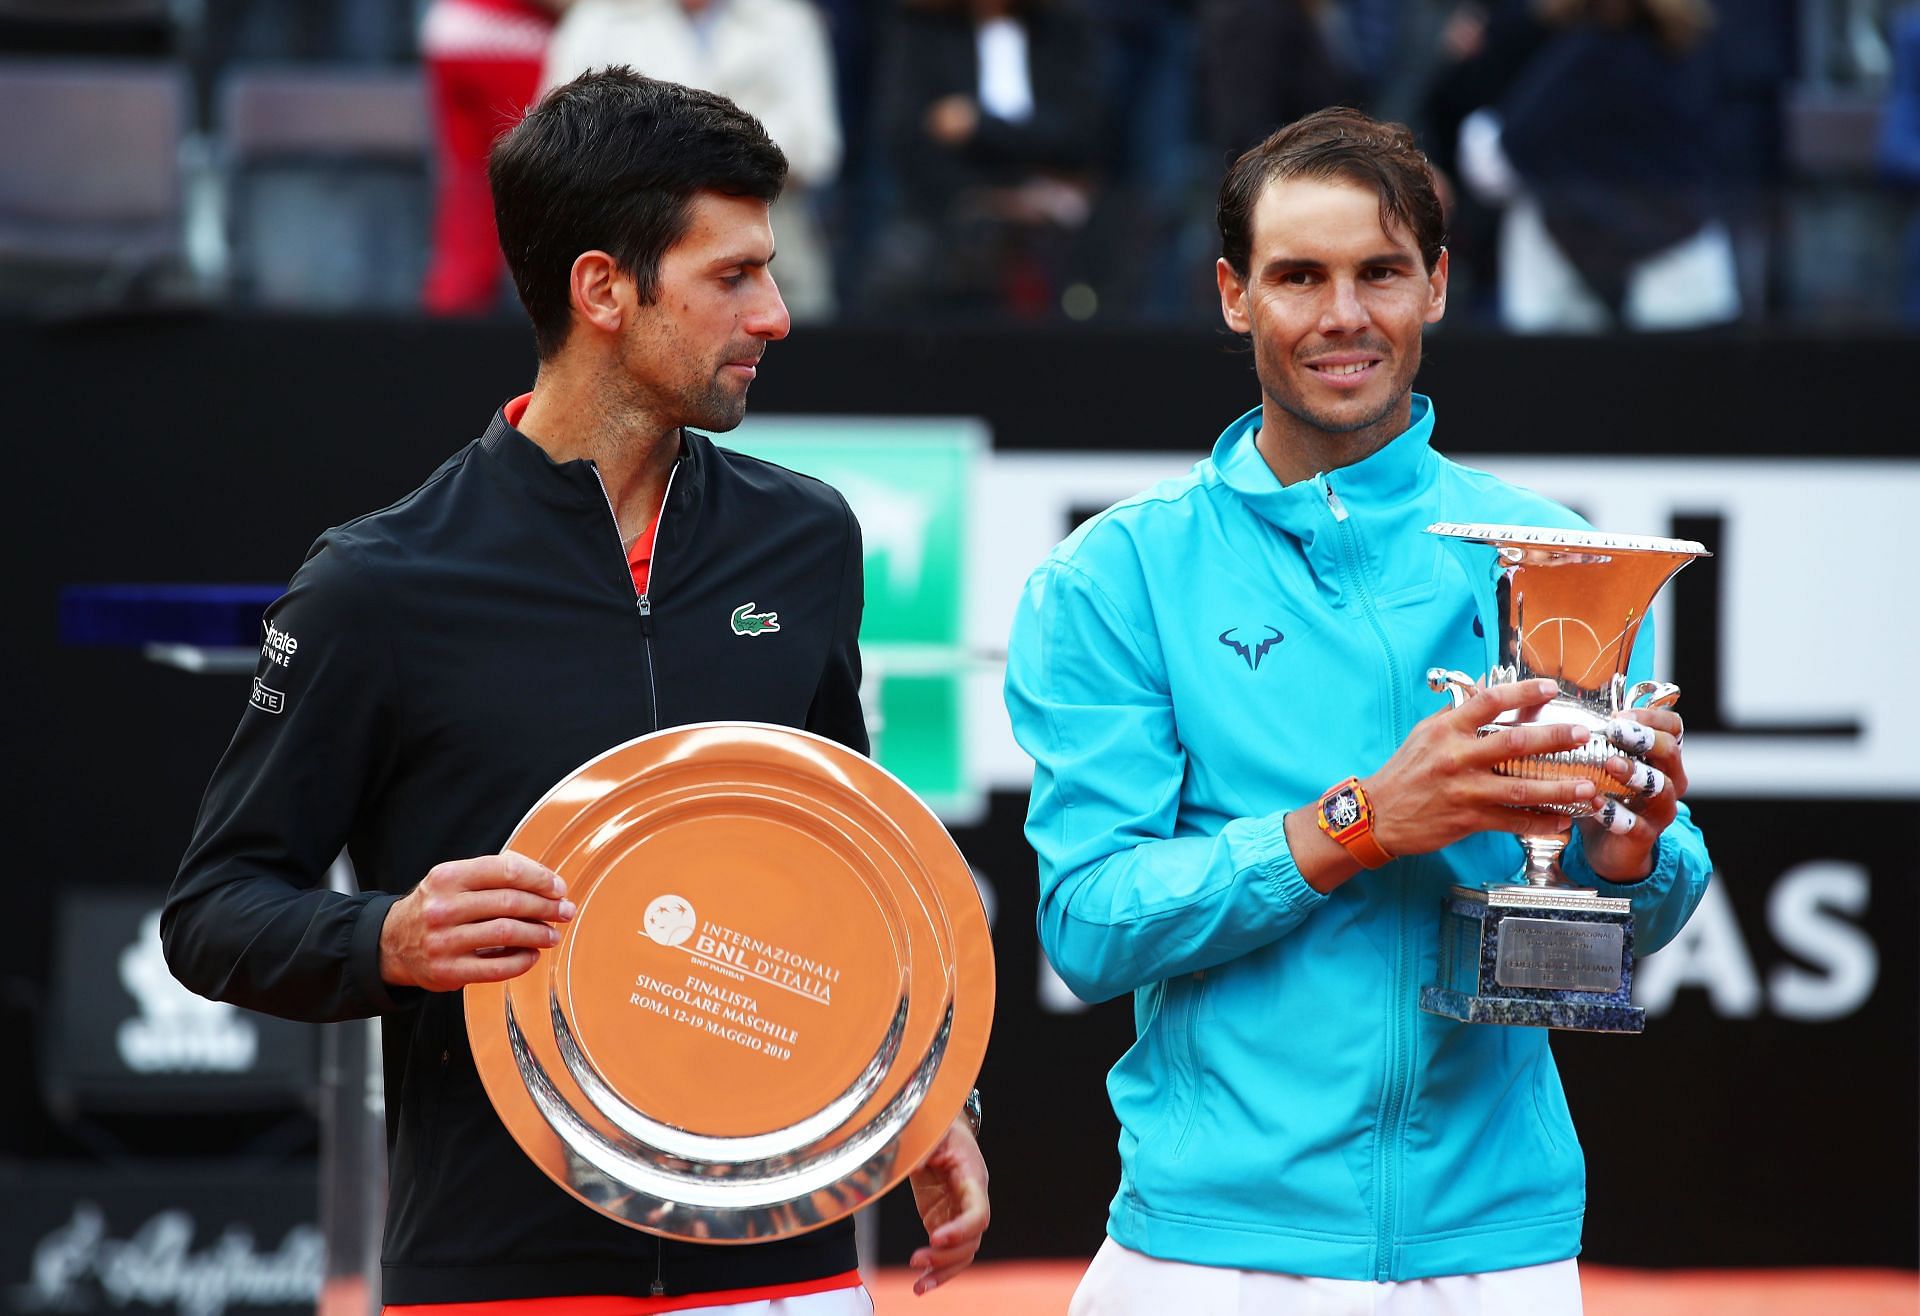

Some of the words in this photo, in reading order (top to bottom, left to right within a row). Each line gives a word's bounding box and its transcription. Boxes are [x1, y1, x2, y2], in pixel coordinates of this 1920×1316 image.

[690, 957, 709, 971] BNP
[709, 963, 746, 982] PARIBAS
[695, 934, 750, 969] BNL
[754, 959, 832, 1001] D'ITALIA
[702, 921, 840, 984] INTERNAZIONALI
[635, 973, 721, 1016] SINGOLARE
[721, 1005, 799, 1045] MASCHILE
[685, 975, 759, 1013] FINALISTA
[629, 992, 670, 1017] ROMA
[672, 1007, 704, 1028] 12-19
[704, 1020, 762, 1051] MAGGIO
[763, 1042, 791, 1062] 2019
